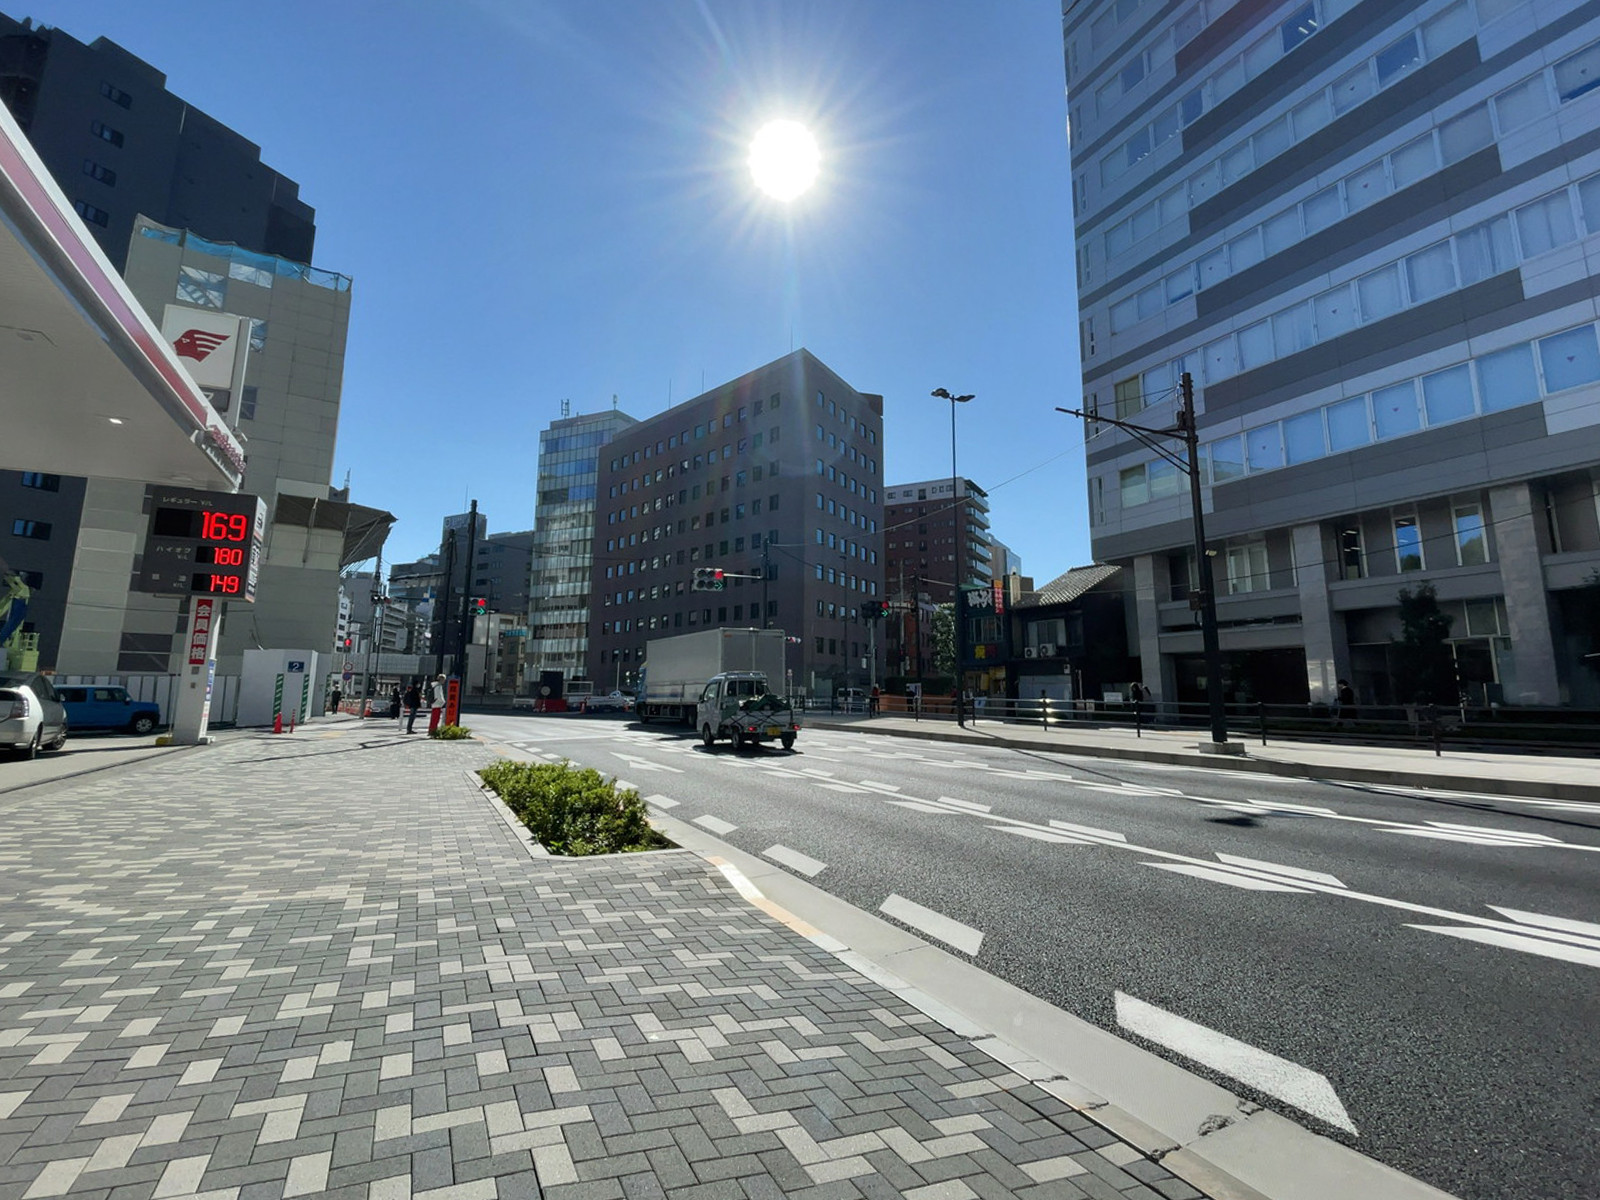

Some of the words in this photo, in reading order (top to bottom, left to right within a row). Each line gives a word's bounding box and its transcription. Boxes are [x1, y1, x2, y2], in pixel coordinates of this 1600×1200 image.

[202, 512, 247, 541] 169
[213, 547, 243, 566] 180
[210, 574, 239, 593] 149
[191, 604, 212, 660] 会員価格
